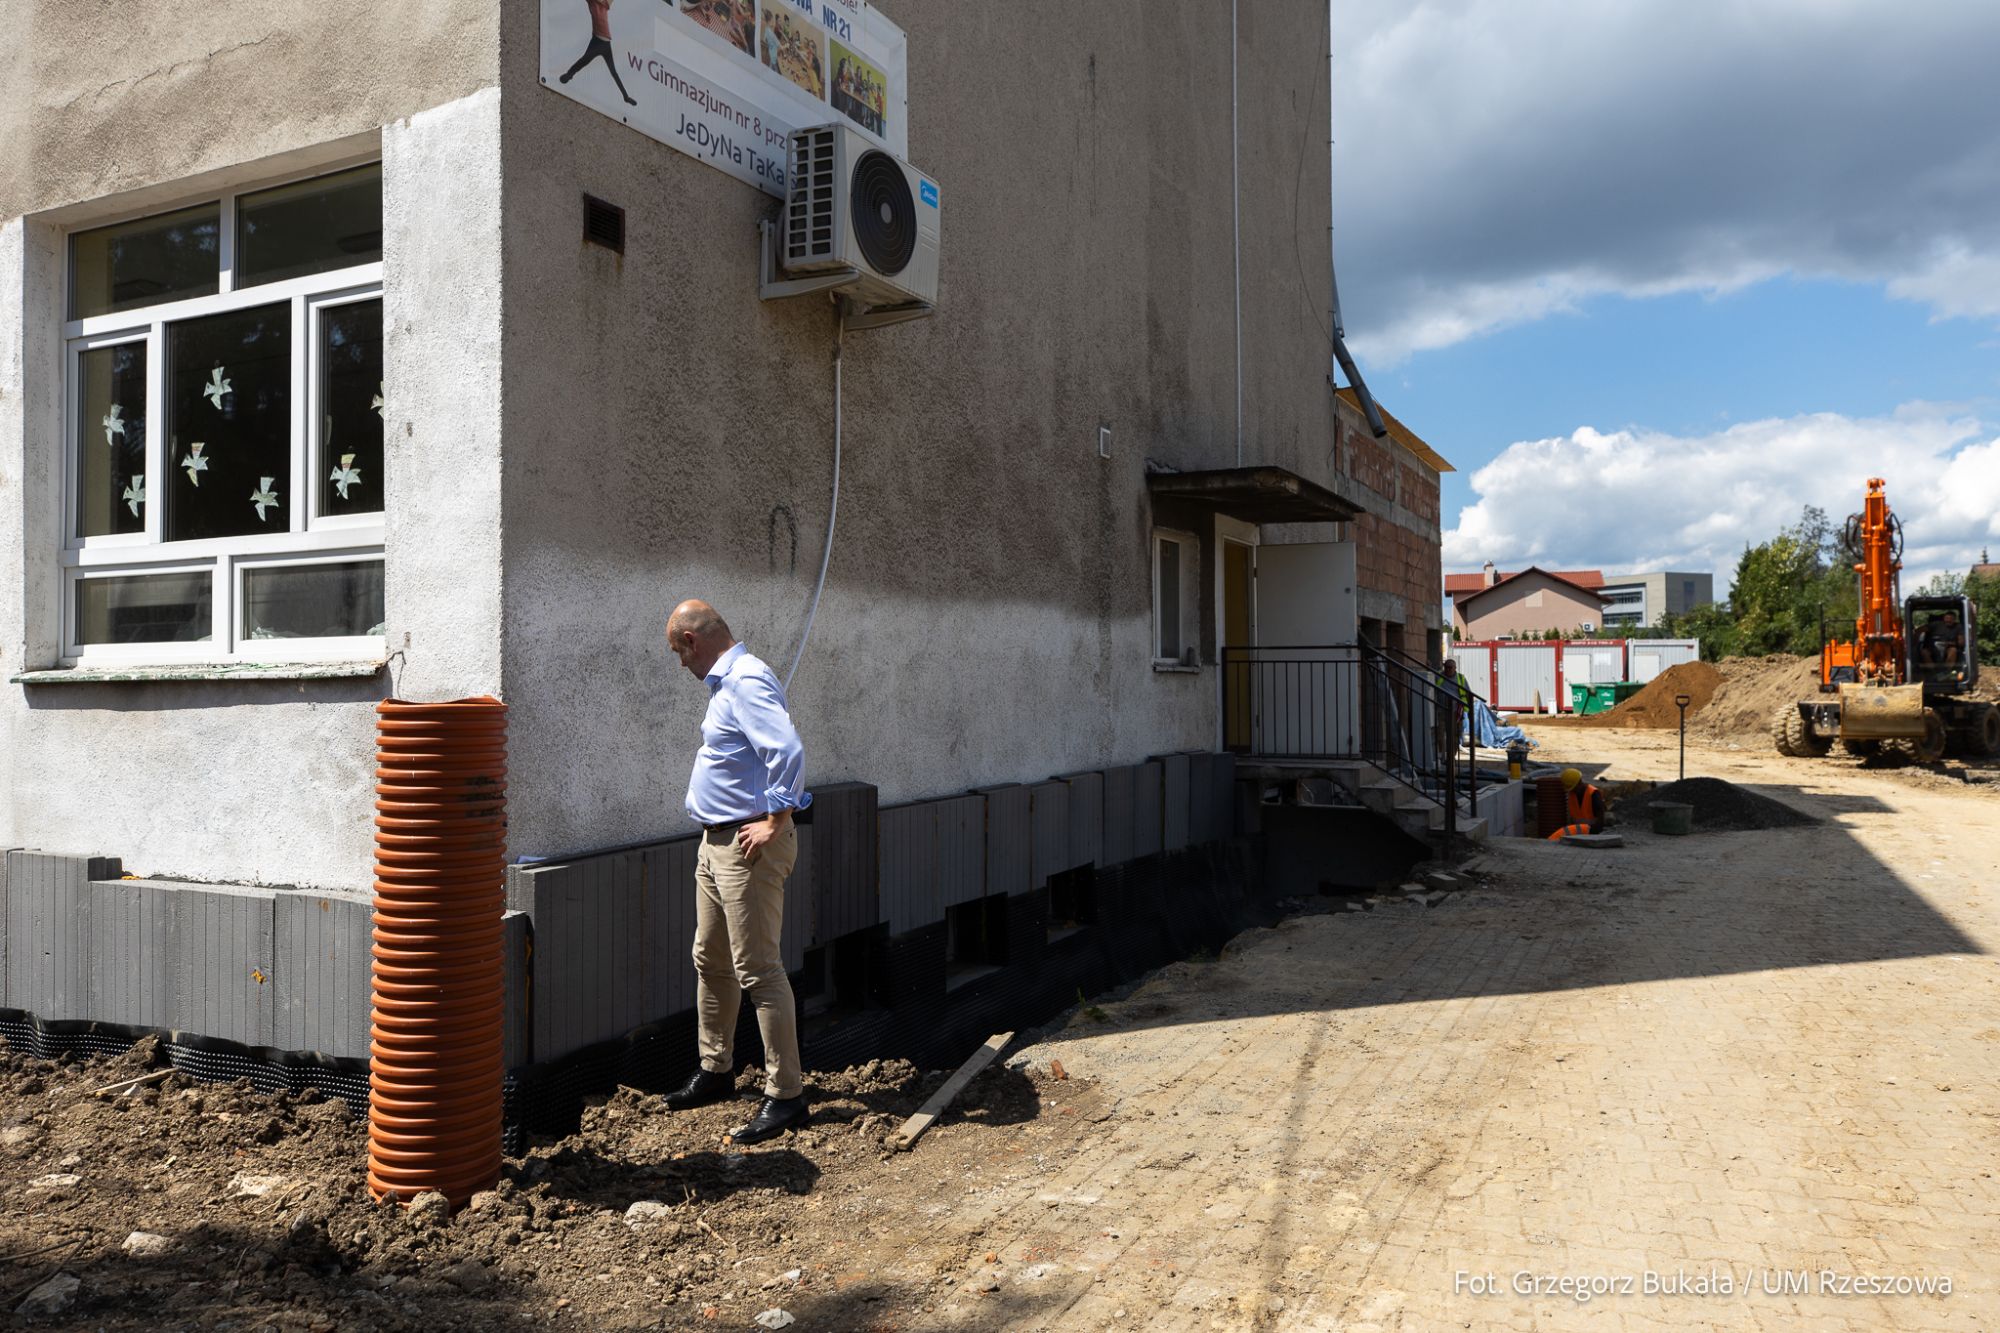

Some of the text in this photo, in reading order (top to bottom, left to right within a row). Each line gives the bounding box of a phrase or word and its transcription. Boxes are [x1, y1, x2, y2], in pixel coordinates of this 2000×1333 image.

[822, 4, 837, 32] NR
[839, 17, 851, 42] 21
[627, 51, 787, 149] w Gimnazjum nr 8 prz
[676, 113, 742, 165] JeDyNa
[746, 147, 785, 185] TaKa
